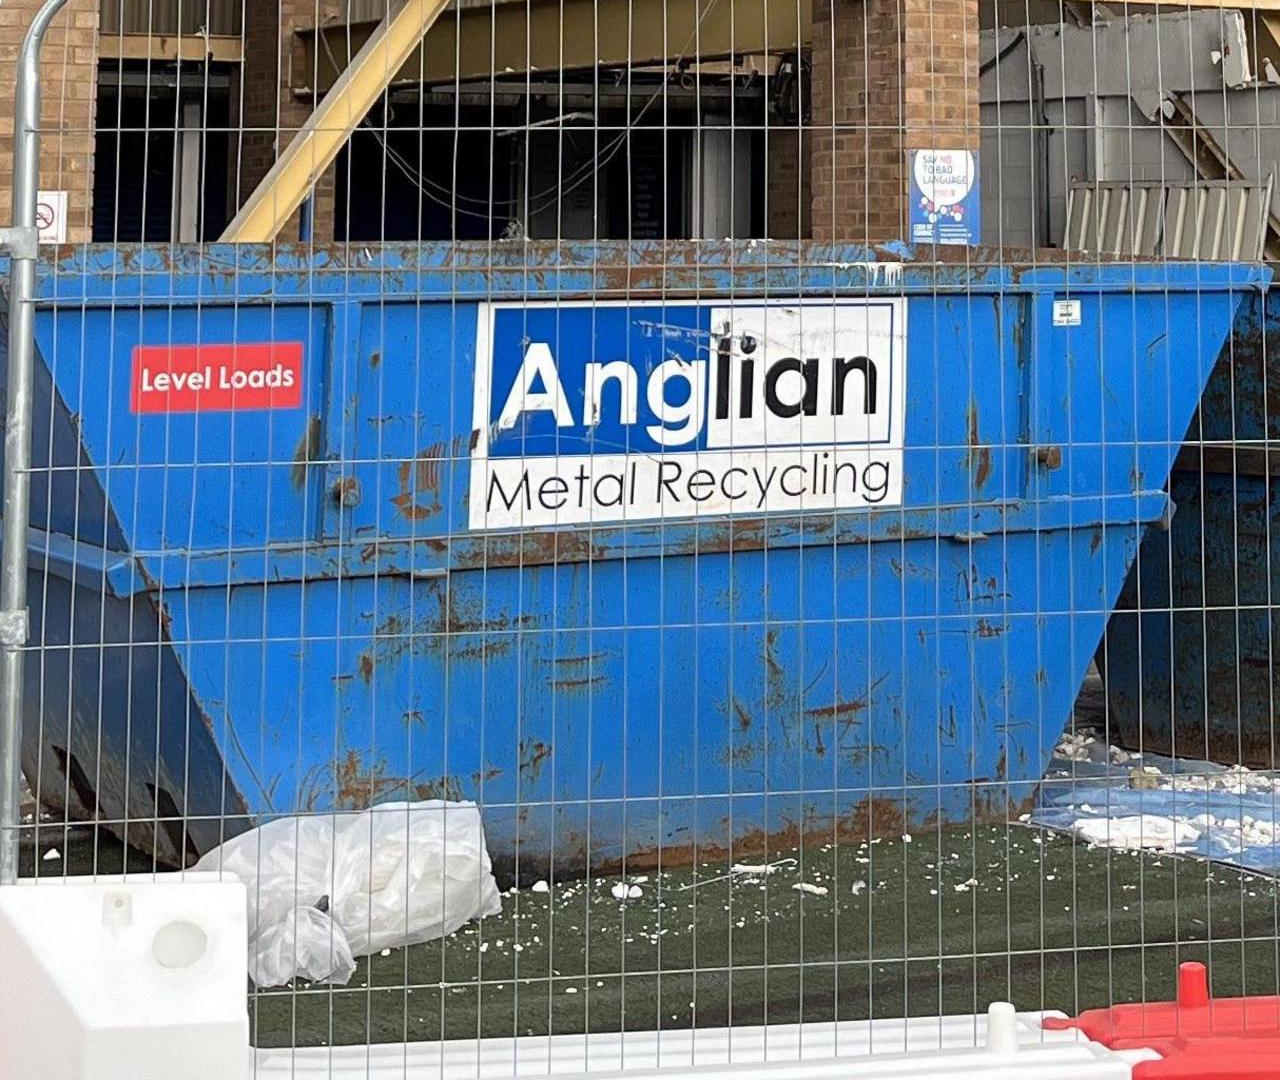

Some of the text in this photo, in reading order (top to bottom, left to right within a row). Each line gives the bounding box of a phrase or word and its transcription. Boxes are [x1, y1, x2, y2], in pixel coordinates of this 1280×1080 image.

[141, 363, 295, 393] Level Loads
[499, 334, 877, 447] Anglian
[485, 453, 890, 513] Metal Recycling
